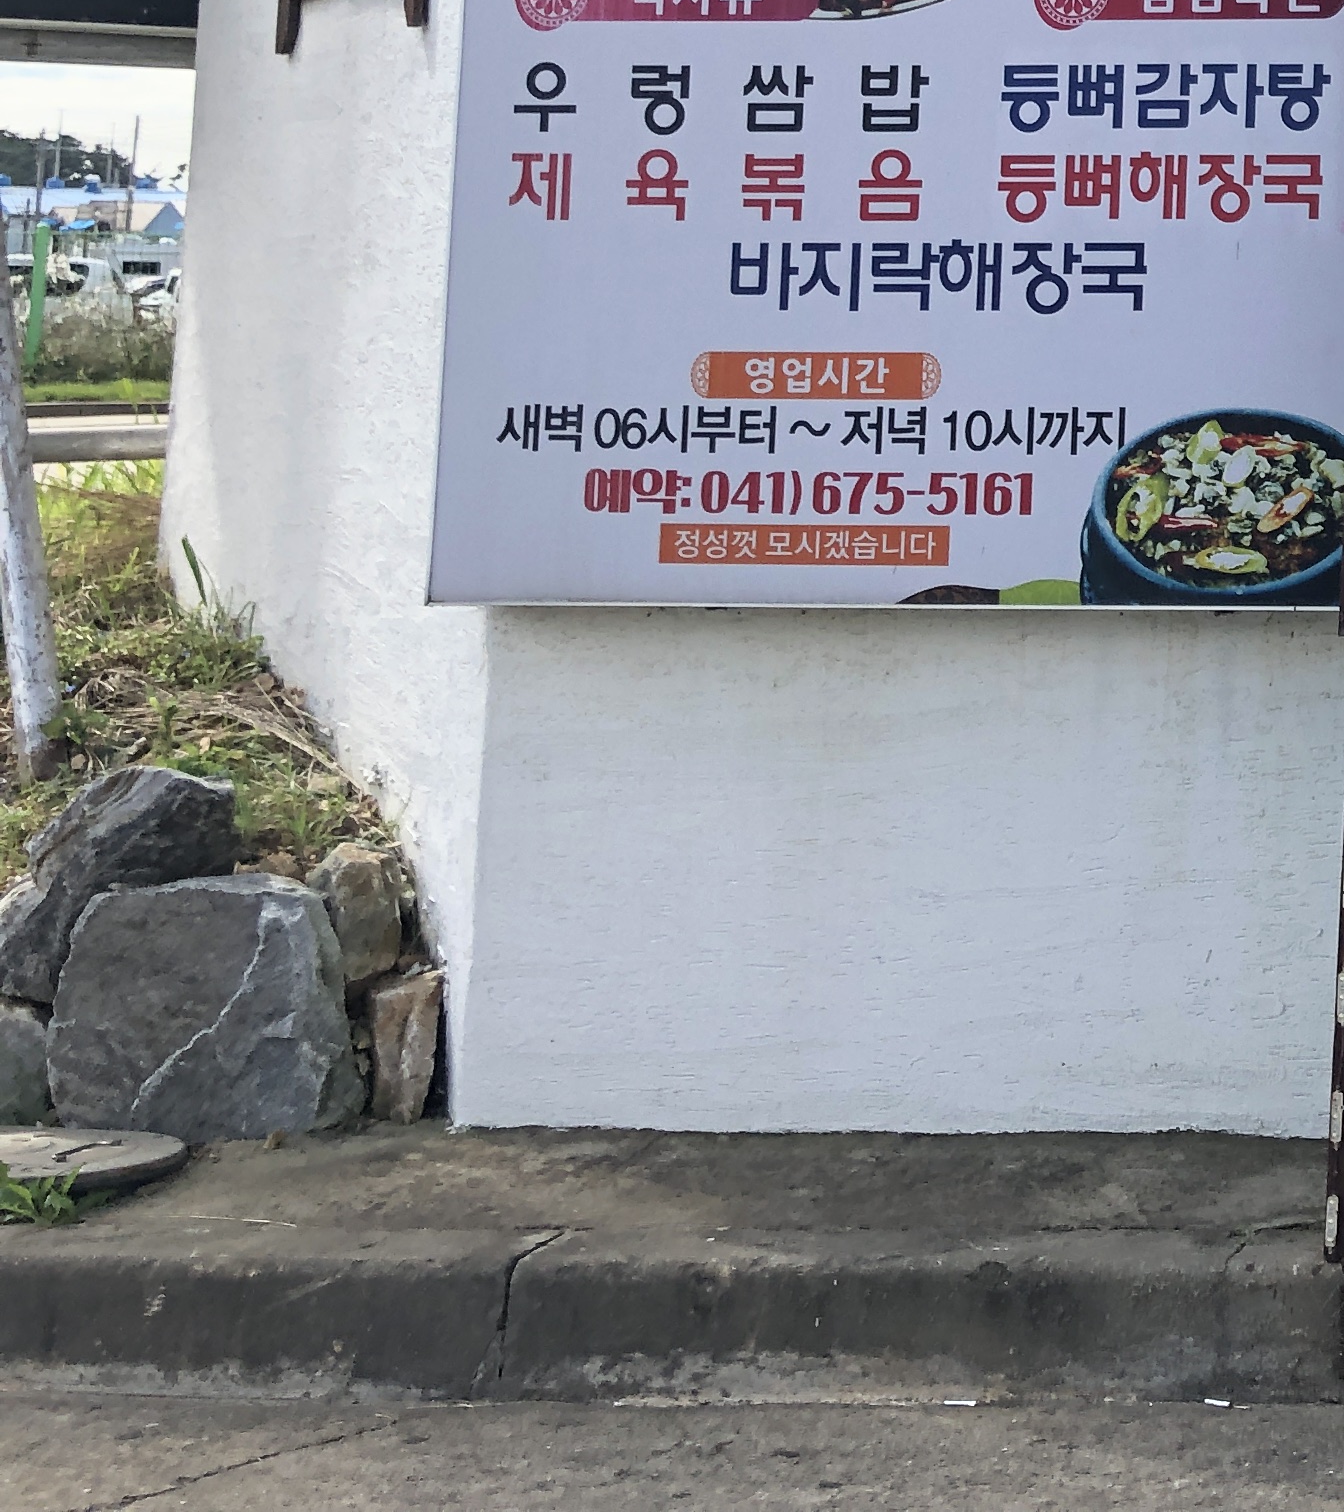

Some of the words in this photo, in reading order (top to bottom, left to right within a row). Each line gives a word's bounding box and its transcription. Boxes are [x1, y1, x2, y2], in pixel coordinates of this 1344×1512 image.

[1000, 61, 1331, 133] 등뼈감자탕
[998, 150, 1324, 223] 등뼈해장국
[730, 240, 1148, 314] 바지락해장국
[744, 357, 890, 394] 영업시간
[496, 403, 584, 452] 새벽
[594, 404, 777, 454] 06시부터
[840, 405, 927, 455] 저녁
[943, 406, 1126, 455] 10시까지
[583, 468, 693, 515] 예약:
[701, 470, 803, 516] 041)
[812, 470, 1033, 516] 675-5161
[674, 529, 757, 559] 정성껏
[765, 530, 936, 561] 모시겠습니다
